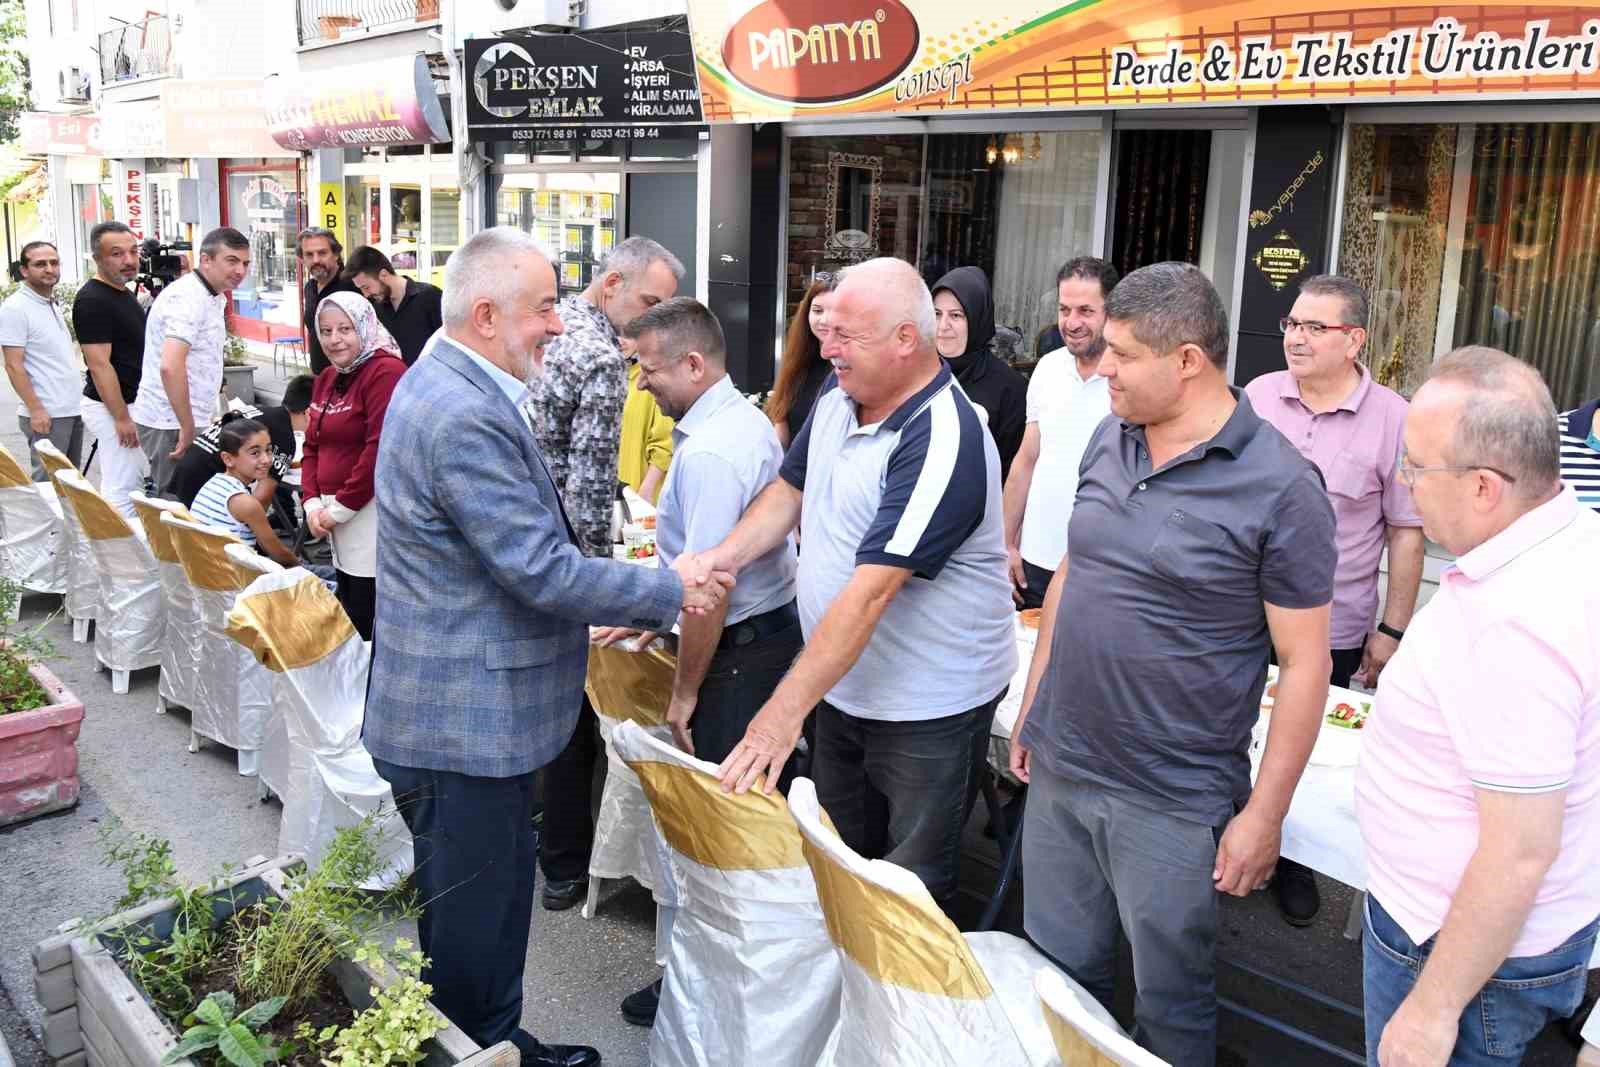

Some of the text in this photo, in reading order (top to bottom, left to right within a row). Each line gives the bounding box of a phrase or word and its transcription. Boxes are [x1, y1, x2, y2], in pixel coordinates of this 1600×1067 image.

[631, 46, 647, 57] EV
[1112, 23, 1598, 85] Perde & Ev Tekstil Ürünleri
[631, 60, 664, 72] ARSA
[493, 65, 599, 96] PEKŞEN
[631, 73, 669, 89] İŞYERİ
[895, 53, 970, 101] consept
[631, 89, 699, 101] ALIM SATIM
[528, 97, 604, 117] EMLAK
[631, 103, 694, 116] KİRALAMA
[590, 128, 613, 138] 0533
[647, 127, 659, 138] 44
